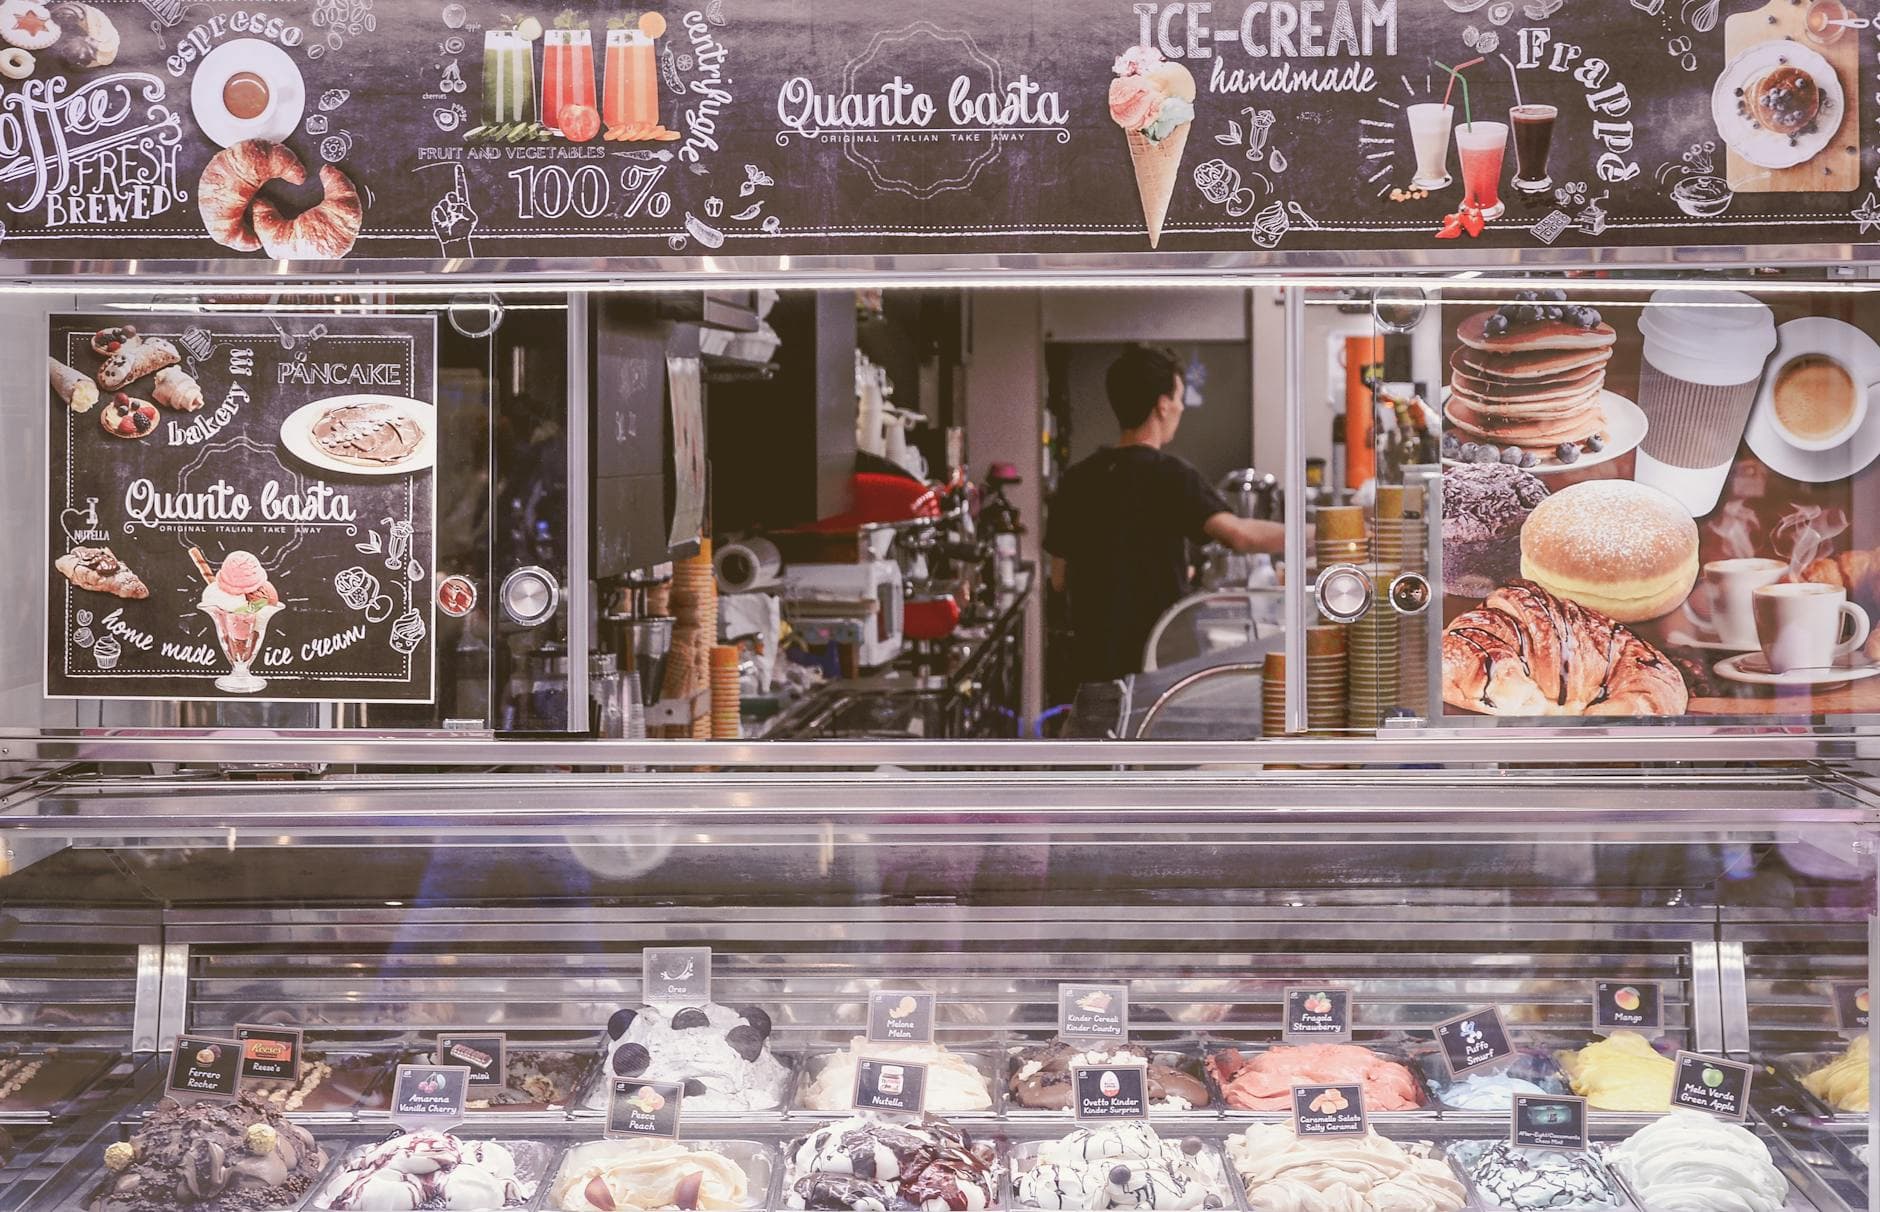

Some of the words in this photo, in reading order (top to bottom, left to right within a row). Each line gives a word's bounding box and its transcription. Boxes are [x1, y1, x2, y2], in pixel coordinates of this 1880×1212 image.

[1133, 1, 1398, 58] ICE-CREAM
[167, 10, 303, 77] espresso
[1210, 56, 1377, 93] handmade
[678, 11, 732, 162] centrifughe
[777, 77, 937, 139] Quanto
[948, 75, 1069, 126] basta
[0, 71, 166, 213] offee
[820, 133, 880, 143] ORIGINAL
[891, 133, 939, 142] ITALIAN
[951, 133, 980, 142] TAKE
[992, 132, 1025, 142] AWAY
[417, 147, 463, 160] FRUIT
[467, 147, 501, 160] AND
[505, 146, 606, 159] VEGETABLES
[69, 138, 188, 202] FRESH
[509, 165, 609, 219] 100
[620, 165, 671, 218] %
[45, 185, 171, 227] BREWED
[277, 362, 402, 386] PANCAKE
[167, 380, 250, 446] bakery
[125, 478, 252, 528] Quanto
[260, 479, 357, 521] basta
[86, 497, 99, 524] I
[74, 530, 110, 541] NUTELLA
[159, 525, 207, 533] ORIGINAL
[296, 526, 322, 534] AWAY
[101, 608, 153, 651] home
[161, 642, 217, 666] made
[264, 647, 293, 666] ice
[301, 624, 367, 662] cream
[1068, 1014, 1093, 1022] Kinder
[1302, 1014, 1333, 1024] Fragola
[1614, 1012, 1643, 1023] Mango
[887, 1019, 915, 1029] Melone
[1066, 1023, 1092, 1032] Kinder
[1092, 1024, 1121, 1035] Country
[1293, 1022, 1342, 1033] Strawberry
[888, 1029, 912, 1038] Melon
[1466, 1041, 1489, 1055] Puffo
[1467, 1048, 1495, 1065] Smurf
[253, 1062, 281, 1072] Reese's
[188, 1067, 221, 1080] Ferrero
[187, 1078, 218, 1090] Rocher
[1684, 1082, 1706, 1096] Mela
[1709, 1087, 1735, 1101] Verde
[409, 1094, 450, 1103] Amarena
[872, 1095, 904, 1107] Nutella
[1083, 1098, 1109, 1107] Ovetto
[1110, 1098, 1139, 1106] Kinder
[1680, 1092, 1708, 1106] Green
[1709, 1099, 1736, 1112] Apple
[399, 1103, 426, 1112] Vanilla
[428, 1104, 457, 1115] Cherry
[631, 1109, 656, 1120] Pesca
[1083, 1106, 1108, 1114] Kinder
[1109, 1106, 1140, 1116] Surprise
[1337, 1114, 1362, 1123] Salato
[629, 1120, 656, 1131] Peach
[1326, 1122, 1358, 1130] Caramel
